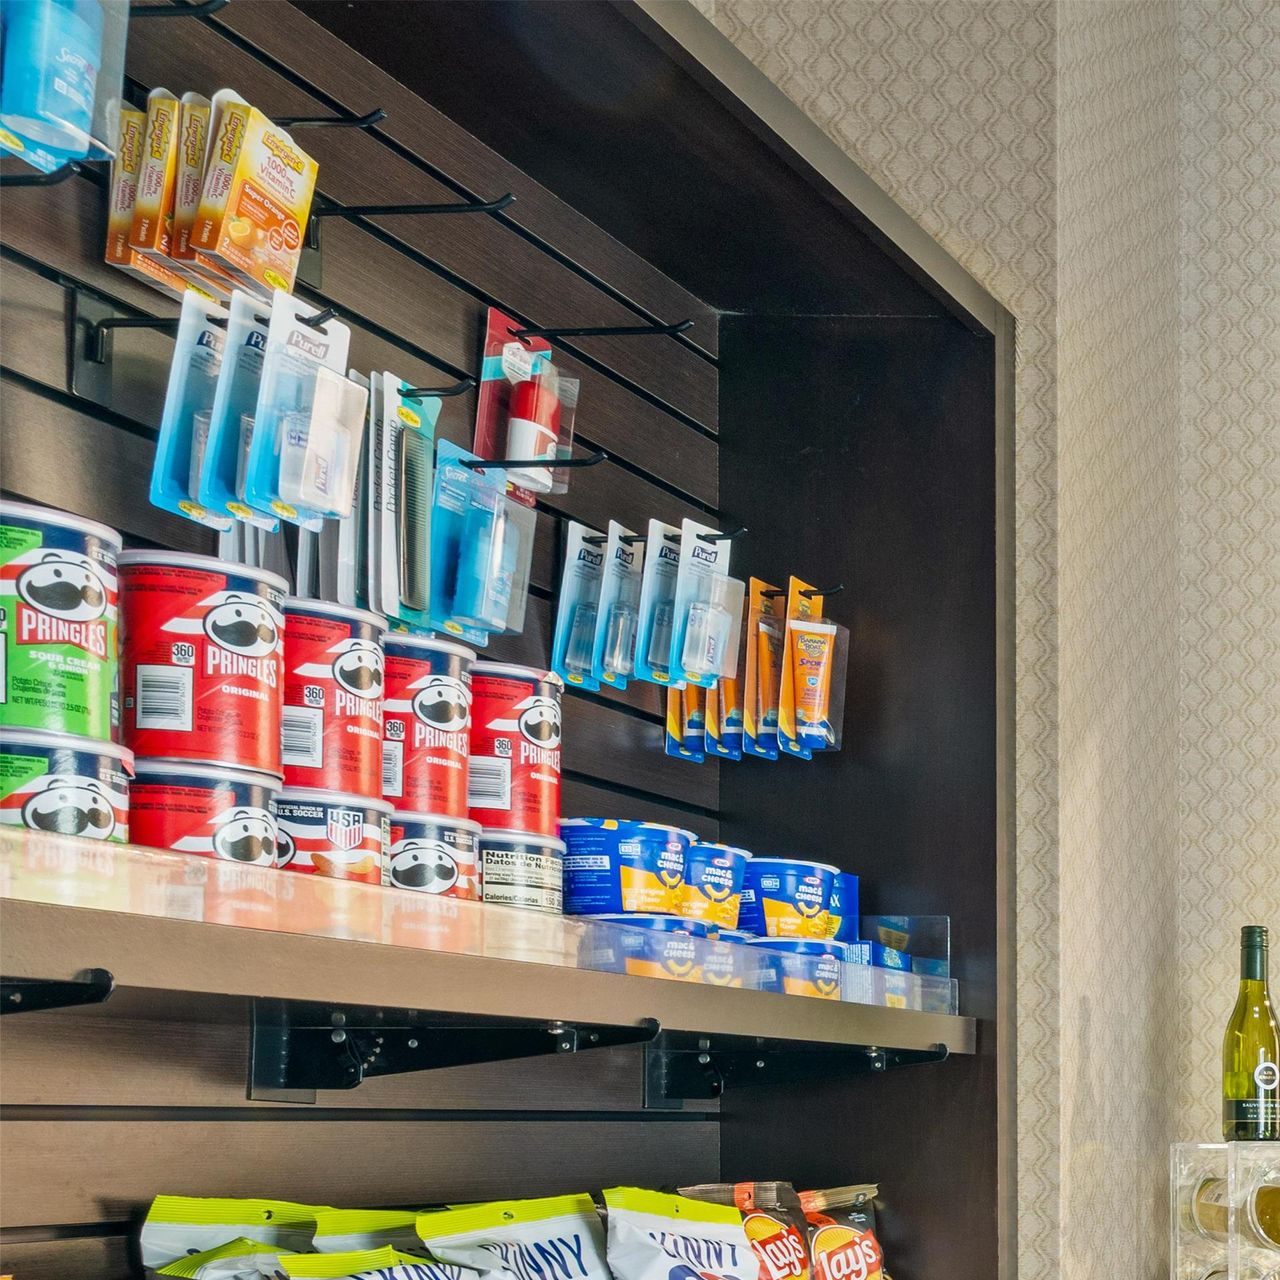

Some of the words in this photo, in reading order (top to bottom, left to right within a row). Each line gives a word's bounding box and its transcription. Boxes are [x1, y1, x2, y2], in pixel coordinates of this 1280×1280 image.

[289, 331, 329, 358] Purell
[694, 547, 717, 563] Purell
[22, 606, 106, 659] PRINGLES
[29, 650, 63, 664] SOUR
[172, 645, 194, 658] 360
[207, 644, 277, 689] PRINGLES
[222, 685, 269, 702] ORIGINAL
[304, 686, 324, 699] 360
[387, 719, 405, 733] 360
[414, 722, 468, 758] PRINGLES
[495, 738, 513, 751] 360
[426, 756, 463, 770] ORIGINAL
[330, 808, 362, 828] USA
